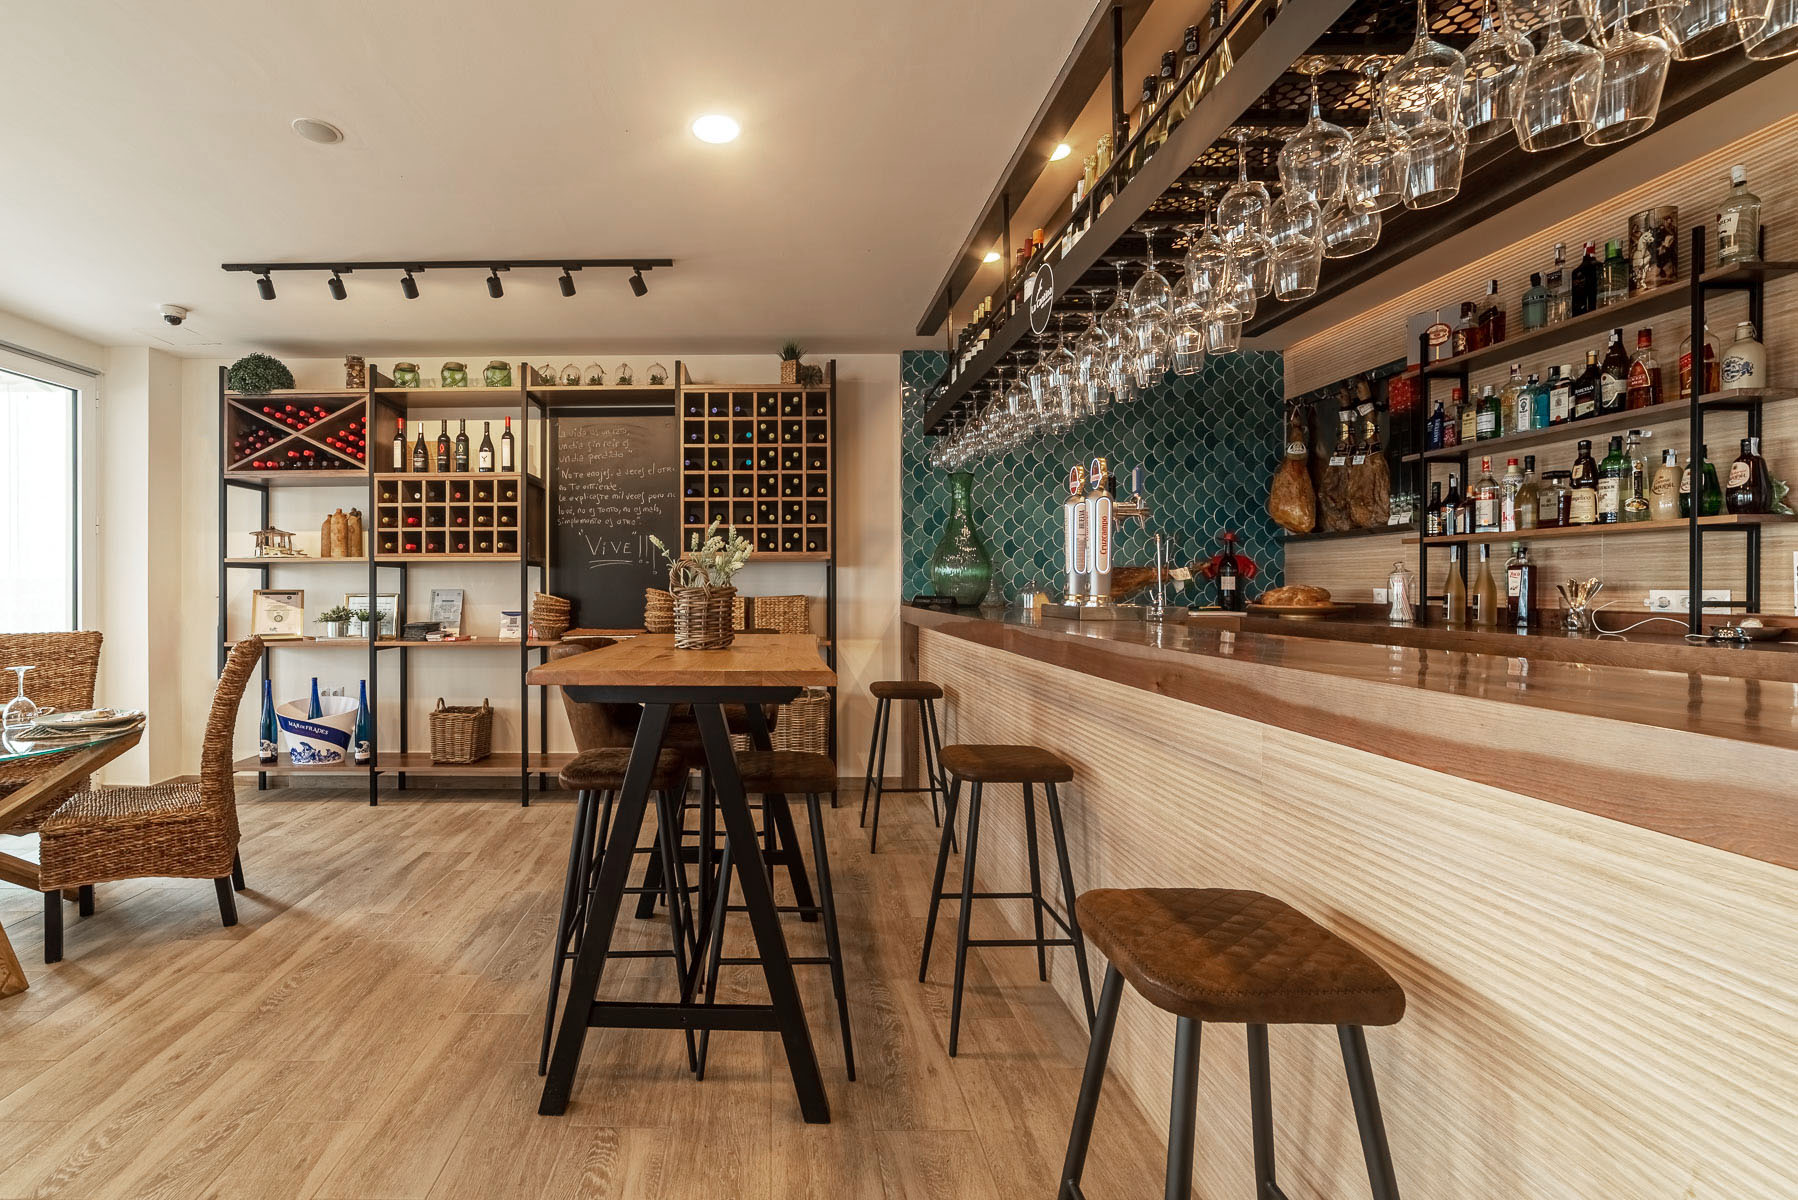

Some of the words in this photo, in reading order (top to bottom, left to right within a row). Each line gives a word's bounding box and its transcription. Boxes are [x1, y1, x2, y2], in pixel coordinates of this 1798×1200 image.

[1100, 515, 1108, 555] Cruzcampo
[288, 720, 300, 729] MAR
[305, 725, 329, 736] FRADES
